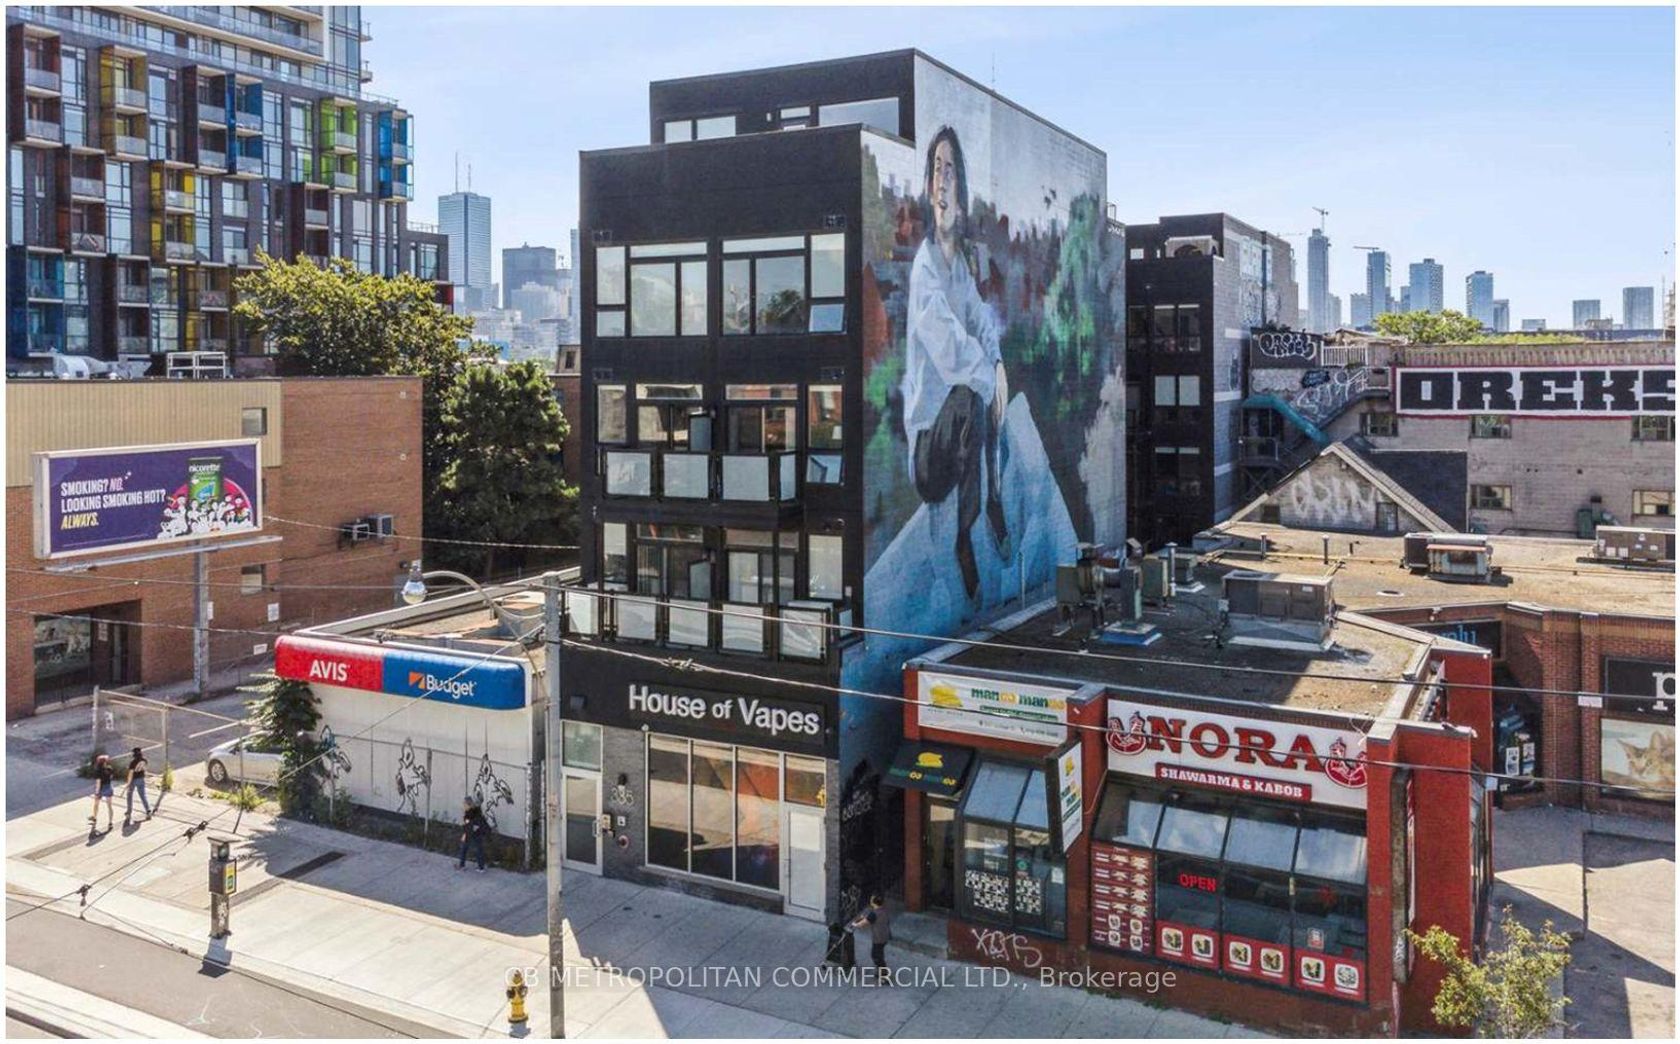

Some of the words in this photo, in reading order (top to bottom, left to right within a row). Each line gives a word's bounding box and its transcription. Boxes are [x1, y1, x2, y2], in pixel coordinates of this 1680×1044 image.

[61, 478, 109, 497] SMOKING?
[61, 495, 101, 513] LOOKING
[102, 491, 143, 508] SMOKING
[143, 488, 166, 504] HOT?
[61, 511, 99, 530] ALWAYS.
[309, 659, 348, 682] AVIS
[426, 674, 476, 699] Budget
[628, 684, 707, 719] House
[712, 700, 734, 720] of
[738, 697, 820, 736] Vapes
[1147, 714, 1326, 773] NORA
[1160, 766, 1240, 789] SHAWARMA
[1242, 779, 1252, 790] &
[1254, 780, 1303, 798] KABOB
[1179, 872, 1217, 893] OPEN
